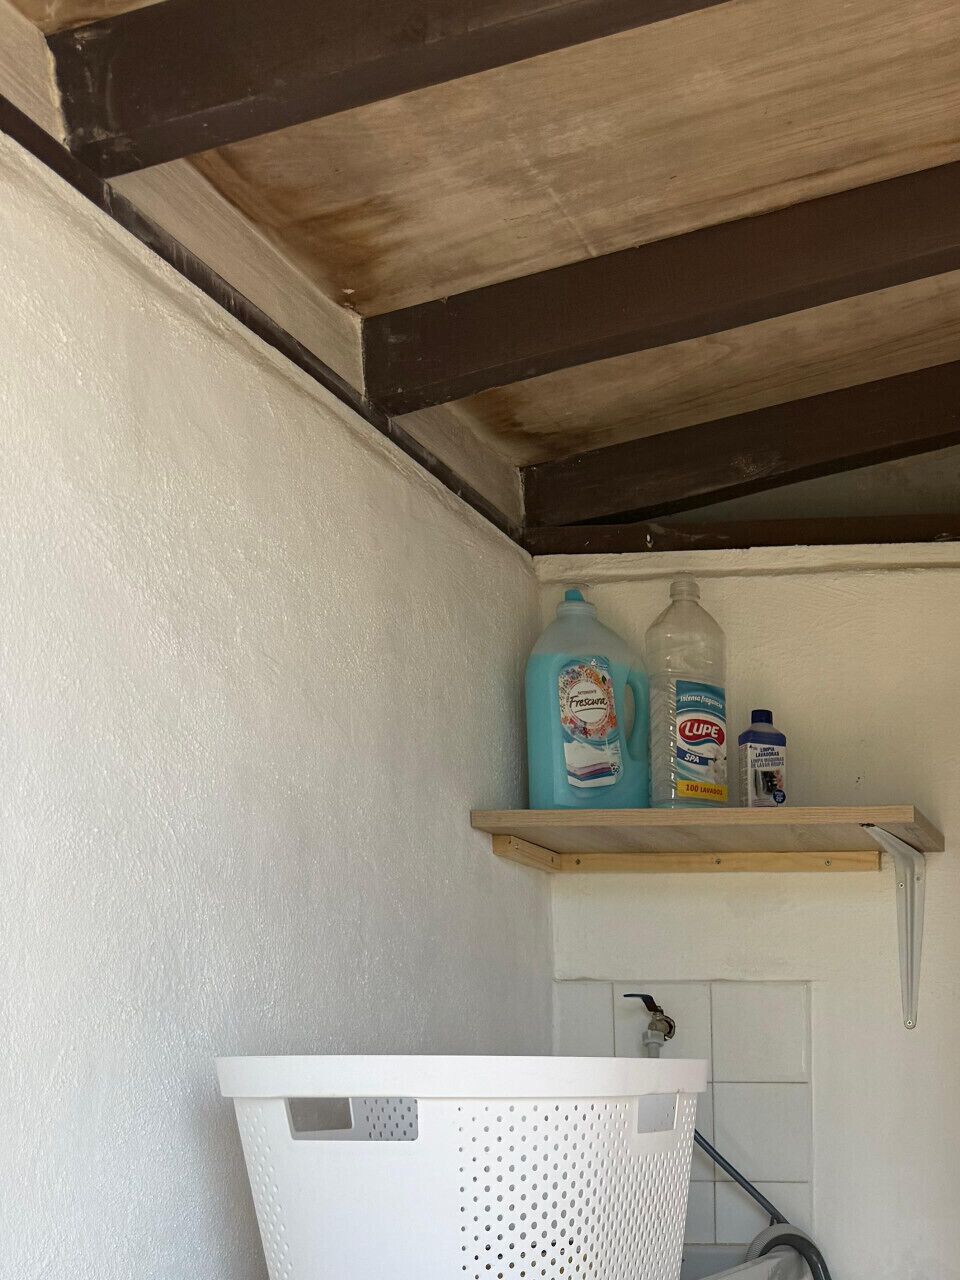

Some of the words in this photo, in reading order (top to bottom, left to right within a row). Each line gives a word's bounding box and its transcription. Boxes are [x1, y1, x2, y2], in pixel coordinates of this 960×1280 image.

[569, 695, 609, 709] Frescura
[685, 721, 719, 739] LUPE
[684, 753, 700, 764] SPA
[755, 751, 780, 759] LAVADORAS
[685, 784, 699, 793] 100
[700, 786, 723, 796] LAVADOS
